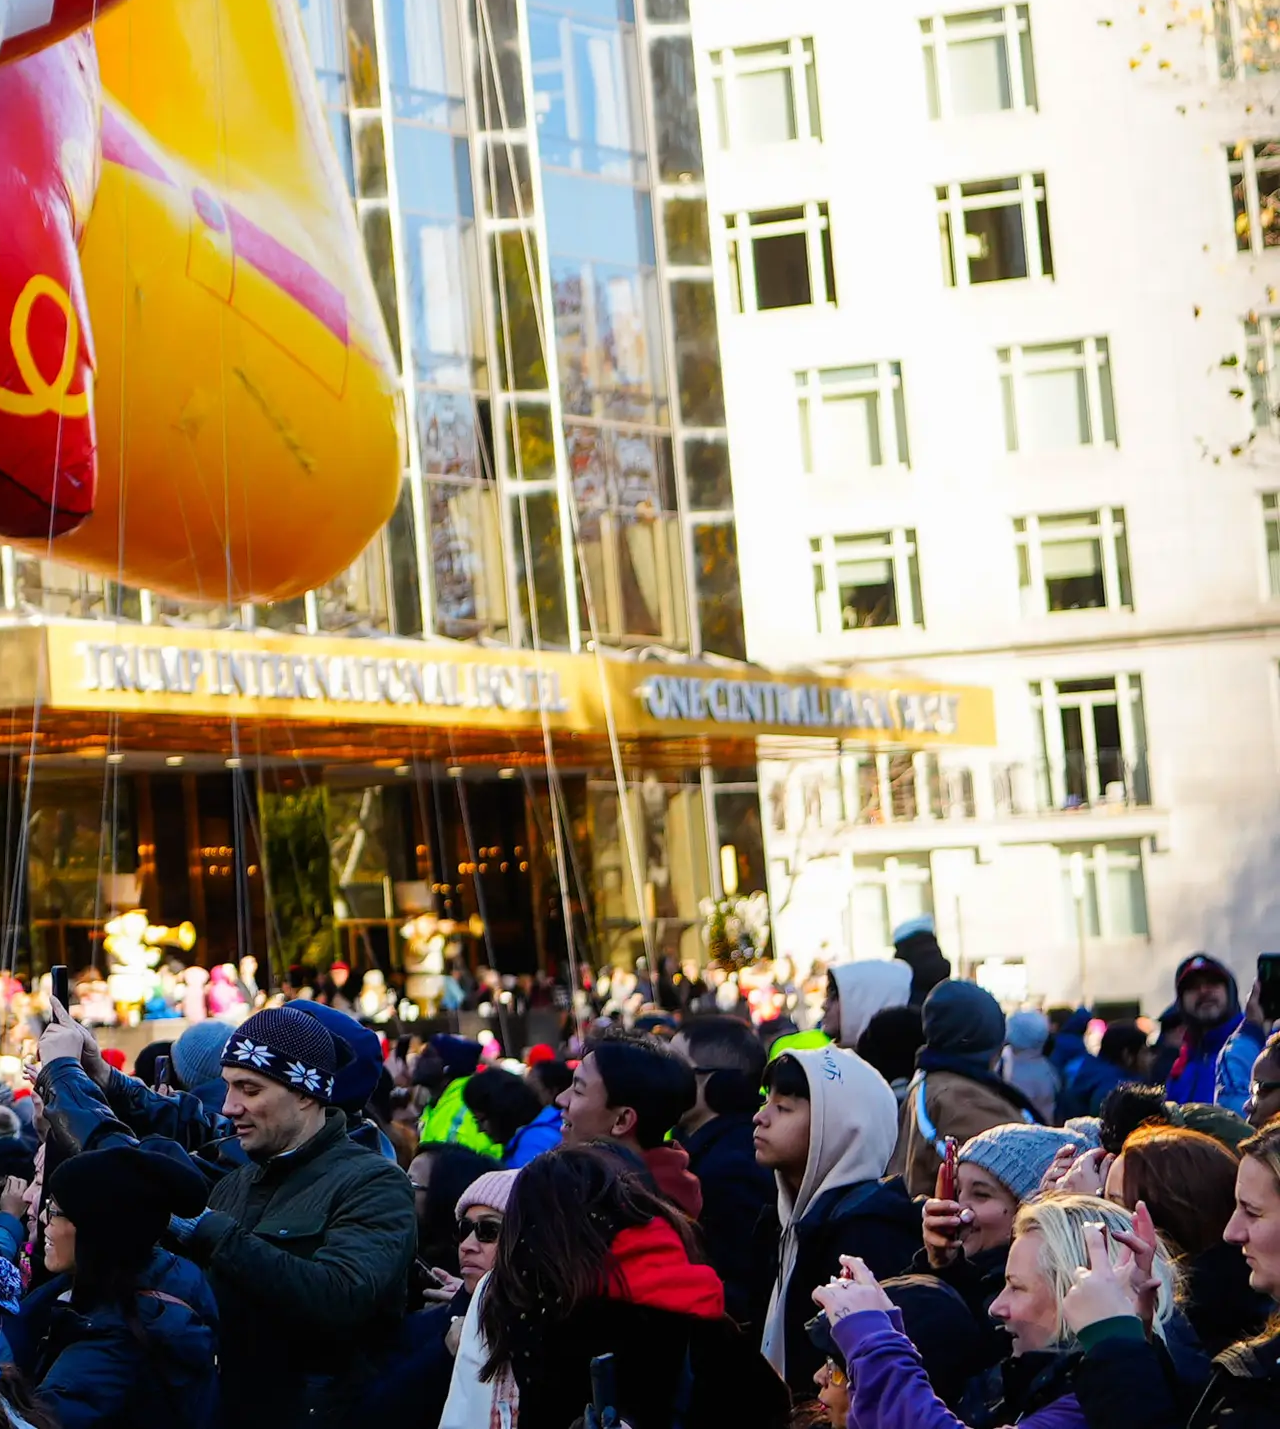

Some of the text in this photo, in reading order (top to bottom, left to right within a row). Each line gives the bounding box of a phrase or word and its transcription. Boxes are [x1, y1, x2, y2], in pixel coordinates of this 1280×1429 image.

[77, 640, 205, 693] TRUMP
[204, 648, 461, 706] INTERNATIONAL
[645, 674, 703, 719] ONE
[706, 678, 827, 726] CENTRAL
